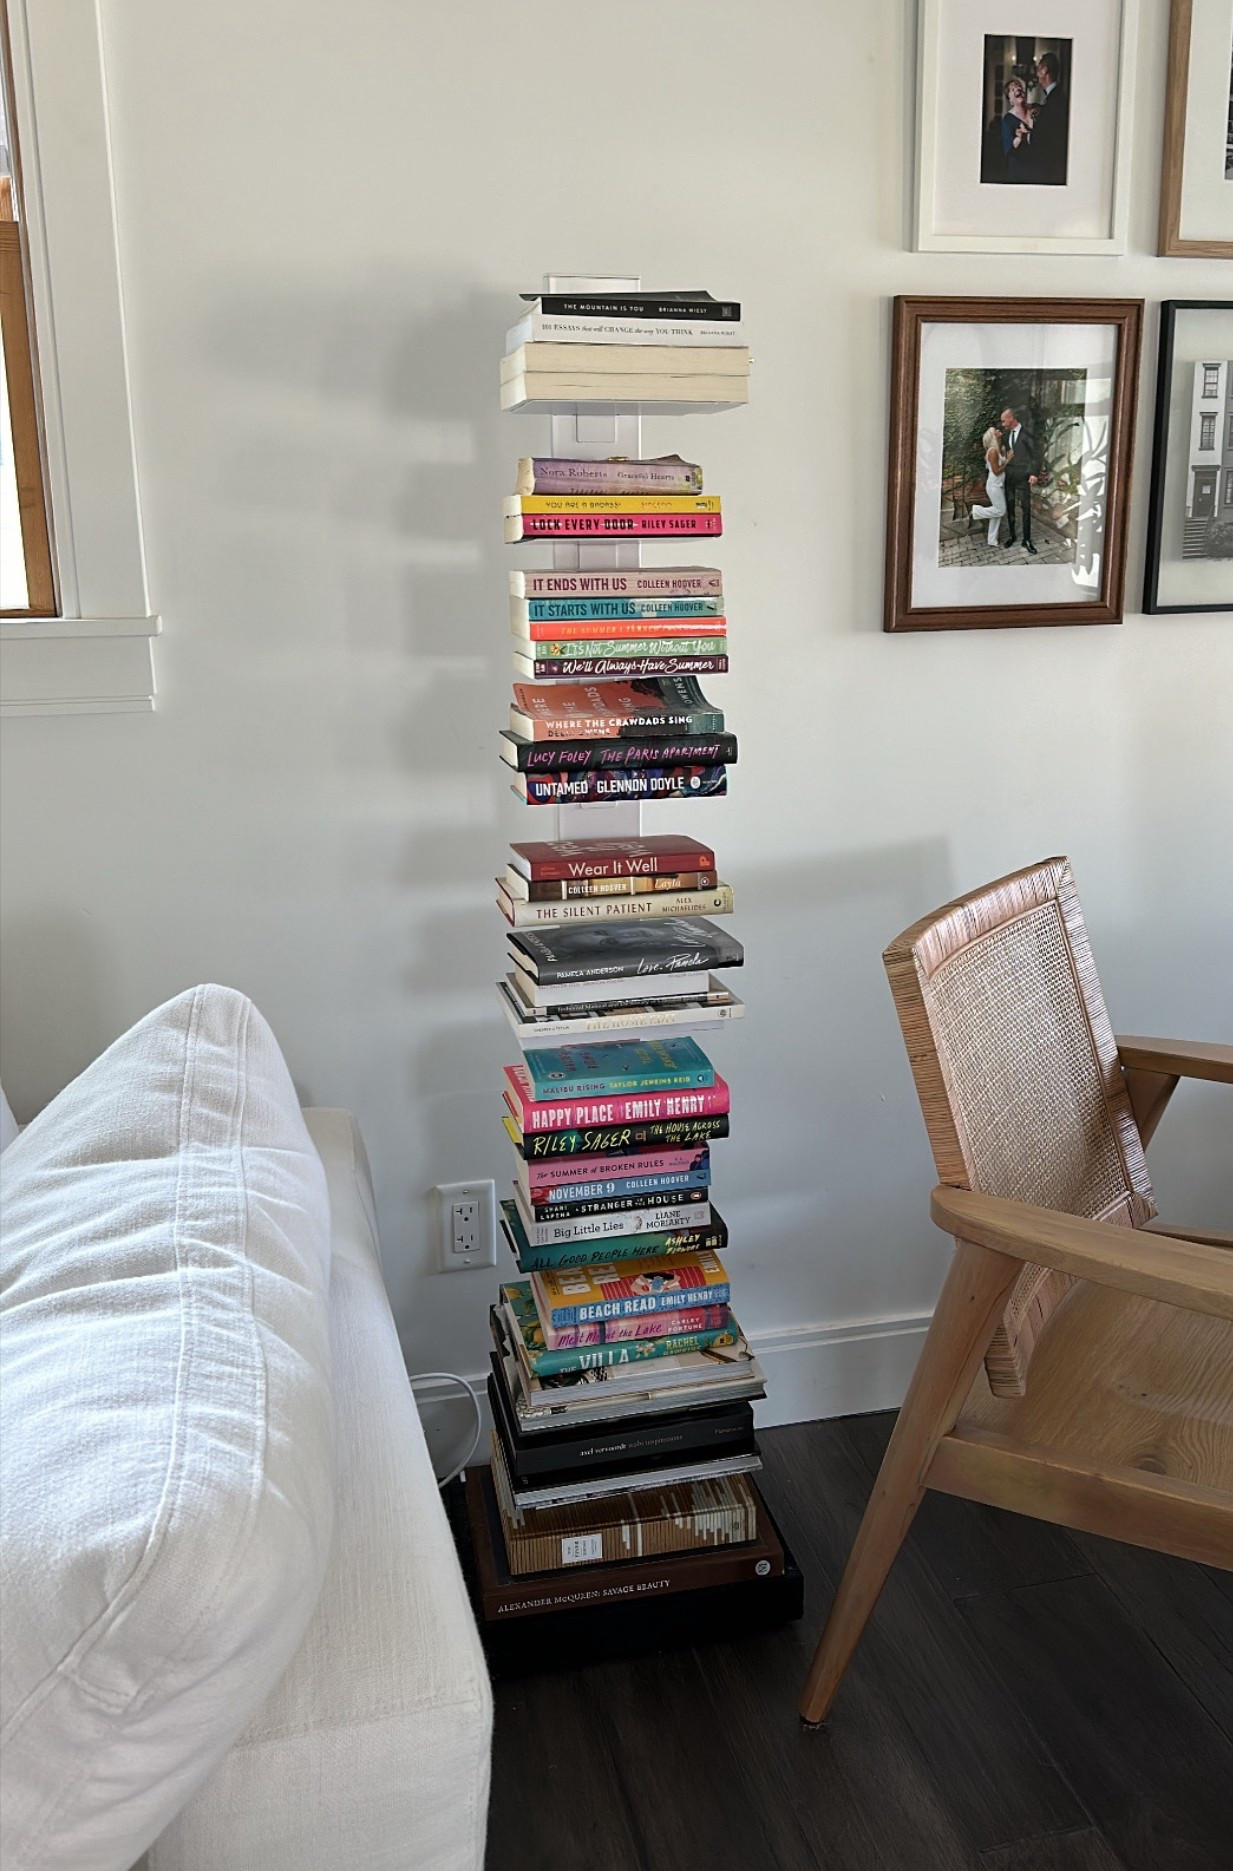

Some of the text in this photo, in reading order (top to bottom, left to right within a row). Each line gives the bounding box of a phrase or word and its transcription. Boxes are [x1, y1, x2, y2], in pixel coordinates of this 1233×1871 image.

[604, 326, 633, 334] CHANGE
[671, 328, 692, 336] THINK
[540, 467, 607, 478] Nora Roberts
[616, 472, 674, 480] Graceful Hearts
[532, 518, 635, 530] LOCK EVERY DOOR
[642, 520, 666, 529] RILEY
[669, 520, 696, 529] SAGER
[533, 578, 627, 590] IT ENDS WITH US
[638, 580, 702, 588] COLLEEN HOOVER
[534, 602, 636, 616] IT STARTS WITH US
[641, 603, 703, 613] COLLEEN HOOVER
[562, 627, 576, 635] THE
[580, 626, 616, 634] SUMMER
[604, 640, 648, 656] Summer
[649, 640, 689, 654] Without
[692, 640, 716, 656] You
[562, 660, 593, 674] We'll
[595, 660, 636, 674] Always
[636, 658, 666, 674] Have
[665, 658, 714, 674] Summer
[674, 678, 692, 705] OWENS
[546, 716, 693, 730] WHERE THE CRAWDADS SING
[527, 750, 592, 766] LUCY FOLEY
[600, 744, 720, 765] THE PARIS APARTMENT
[536, 782, 588, 796] UNTAMED
[596, 776, 684, 794] GLENNON DOYLE
[568, 864, 609, 876] Wear
[614, 861, 624, 874] It
[626, 857, 658, 873] Well
[568, 883, 627, 894] COLLEEN HOOVER
[654, 878, 682, 890] Layla
[536, 902, 652, 919] THE SILENT PATIENT
[662, 904, 706, 912] MICHAELIDES
[664, 952, 709, 970] Pamela
[556, 966, 624, 979] PAMELA ANDERSON
[586, 1022, 610, 1030] THE
[612, 1017, 646, 1028] HOME
[542, 1083, 606, 1094] MALIBU RISING
[608, 1076, 690, 1089] TAYLOR JENKINS REID
[625, 1096, 704, 1120] EMILY HENRY
[532, 1104, 613, 1128] HAPPY PLACE
[650, 1120, 720, 1134] THE HOUSE ACROSS
[533, 1128, 631, 1156] RILEY SAGER
[666, 1131, 712, 1142] THE LAKE
[537, 1172, 549, 1180] The
[550, 1167, 588, 1178] SUMMER
[590, 1166, 598, 1174] of
[600, 1163, 636, 1173] BROKEN
[638, 1160, 664, 1168] RULES
[626, 1175, 689, 1190] COLLEEN HOOVER
[549, 1182, 616, 1200] NOVEMBER 9
[648, 1194, 684, 1205] HOUSE
[581, 1200, 633, 1214] STRANGER
[540, 1212, 570, 1220] LAPENA
[656, 1210, 681, 1220] LIANE
[646, 1216, 691, 1230] MORIARTY
[554, 1227, 571, 1239] Big
[574, 1222, 601, 1236] Little
[602, 1222, 624, 1232] Lies
[665, 1234, 700, 1246] ASHLEY
[530, 1244, 660, 1270] ALL GOOD PEOPLE HERE
[661, 1294, 686, 1307] EMILY
[688, 1291, 713, 1304] HENRY
[579, 1302, 621, 1320] BEACH
[624, 1298, 656, 1314] READ
[667, 1323, 704, 1333] FORTUNE
[670, 1317, 700, 1326] CARLEY
[618, 1328, 633, 1338] the
[634, 1322, 662, 1338] Lake
[666, 1336, 699, 1350] RACHEL
[580, 1348, 630, 1370] VILLA
[498, 1598, 552, 1613] ALEXANDER
[602, 1584, 635, 1597] SAVAGE
[636, 1579, 671, 1592] BEAUTY
